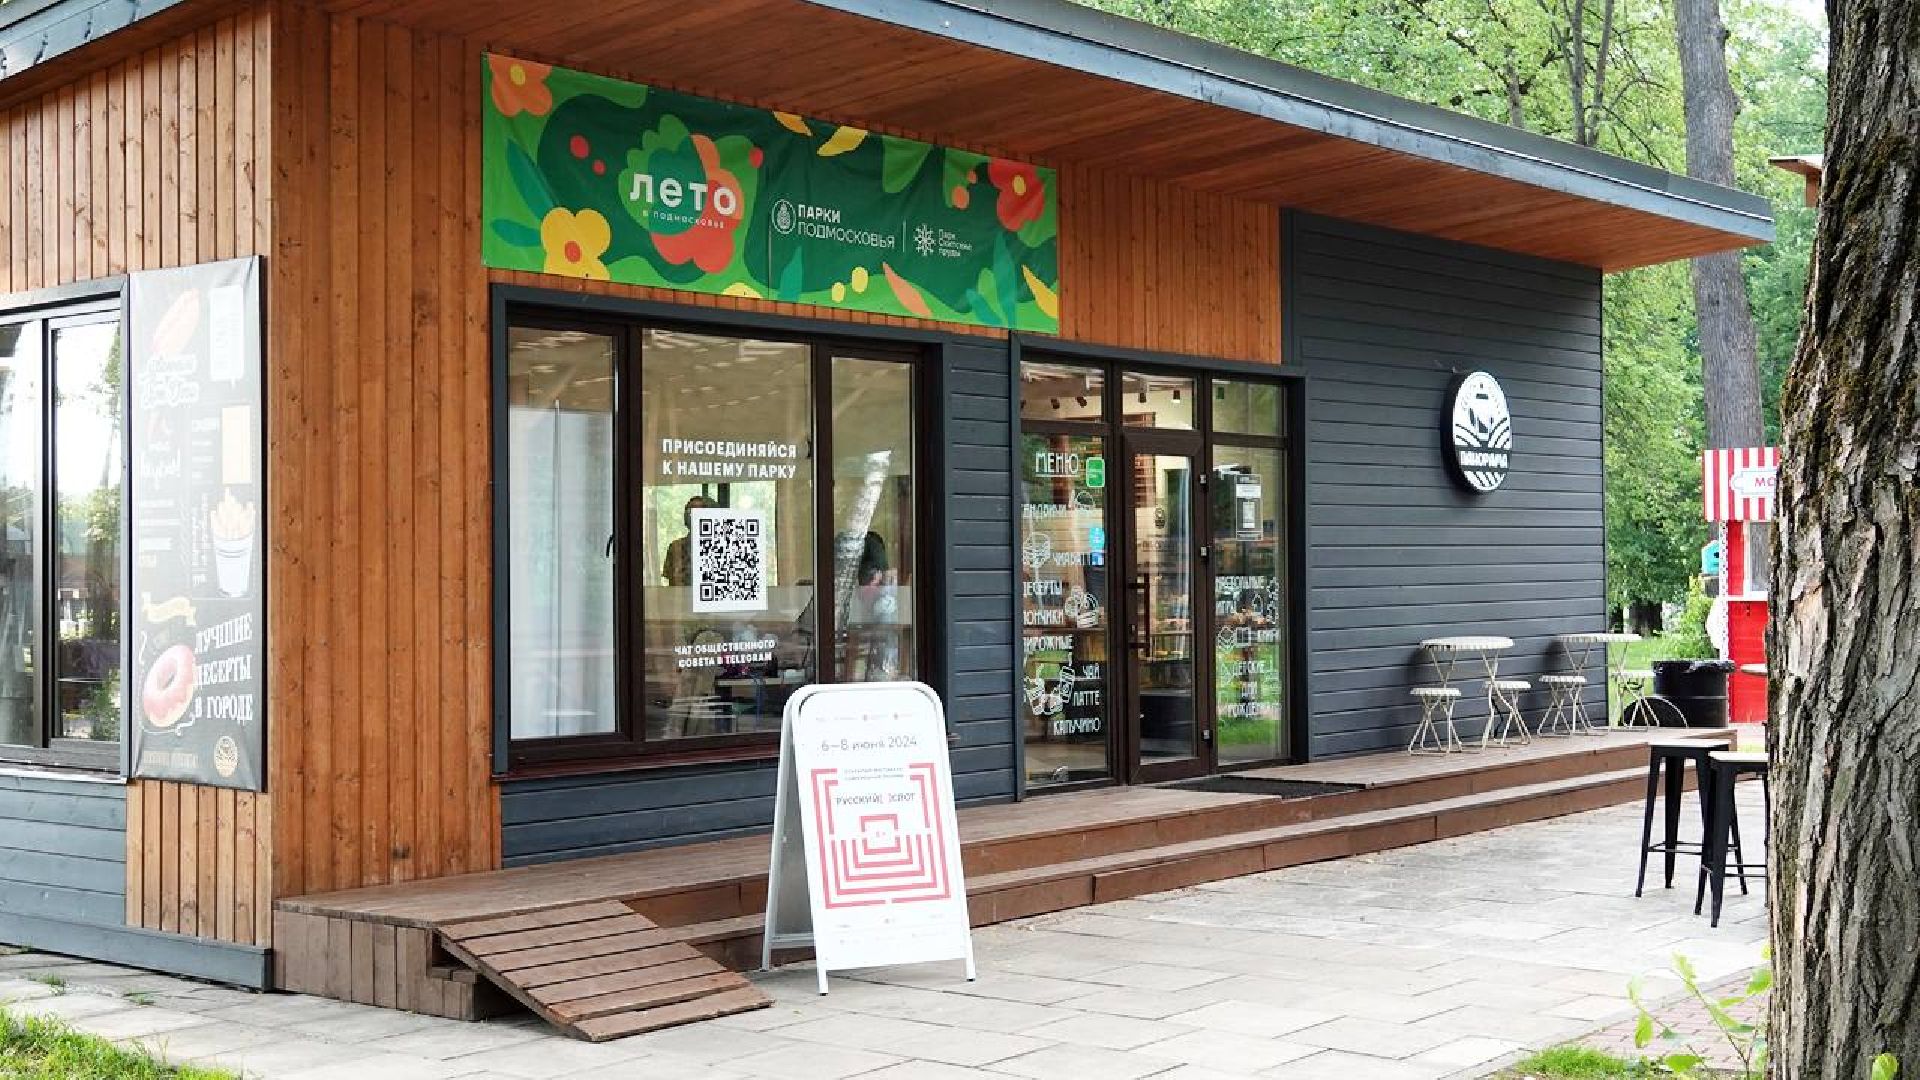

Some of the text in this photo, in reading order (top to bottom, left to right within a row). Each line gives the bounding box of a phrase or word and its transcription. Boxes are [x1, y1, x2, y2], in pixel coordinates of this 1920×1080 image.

[798, 204, 841, 224] ПАРКИ
[798, 221, 895, 249] ПОДМОСКОВЬЯ
[662, 438, 797, 458] ПРИСОЕДИНЯЙСЯ
[662, 459, 797, 479] К НАШЕМУ ПАРКУ
[1035, 452, 1079, 474] МЕНЮ
[195, 612, 252, 654] ЛУЧШИЕ
[674, 639, 776, 655] ЧАТ ОБЩЕСТВЕННОГО
[678, 652, 772, 668] СОВЕТА В TELEGRAM
[1073, 690, 1100, 706] ЛАТТЕ
[195, 693, 253, 725] В ГОРОДЕ
[888, 735, 917, 749] 2024
